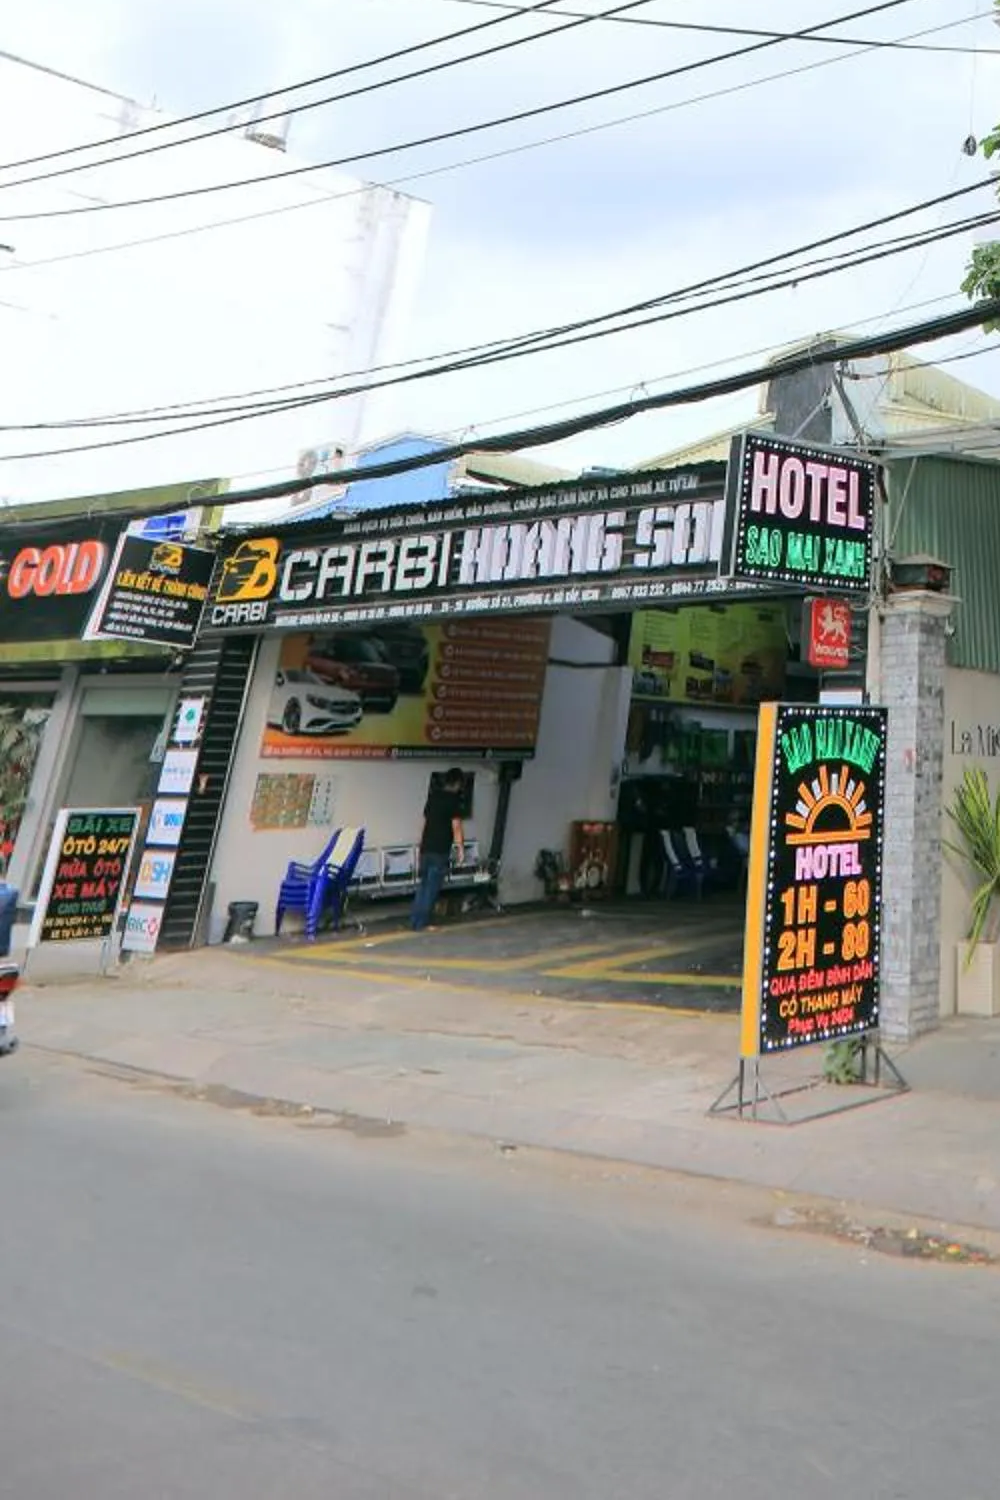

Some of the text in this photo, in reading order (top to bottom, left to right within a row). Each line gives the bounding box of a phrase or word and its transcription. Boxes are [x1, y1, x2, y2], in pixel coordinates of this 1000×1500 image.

[751, 451, 865, 530] HOTEL
[8, 539, 105, 598] GOLD
[279, 531, 453, 602] CARBI
[746, 525, 865, 578] SAO MAI XANH
[211, 602, 268, 625] CARBI
[63, 836, 130, 855] ÔTÔ 24/7
[106, 817, 133, 832] XE
[795, 842, 862, 881] HOTEL
[53, 876, 119, 899] XE MÁY
[780, 884, 818, 926] 1H
[843, 878, 870, 919] 60
[776, 927, 817, 971] 2H
[841, 919, 870, 961] 80
[778, 982, 863, 1018] CÓ THANG MÁY
